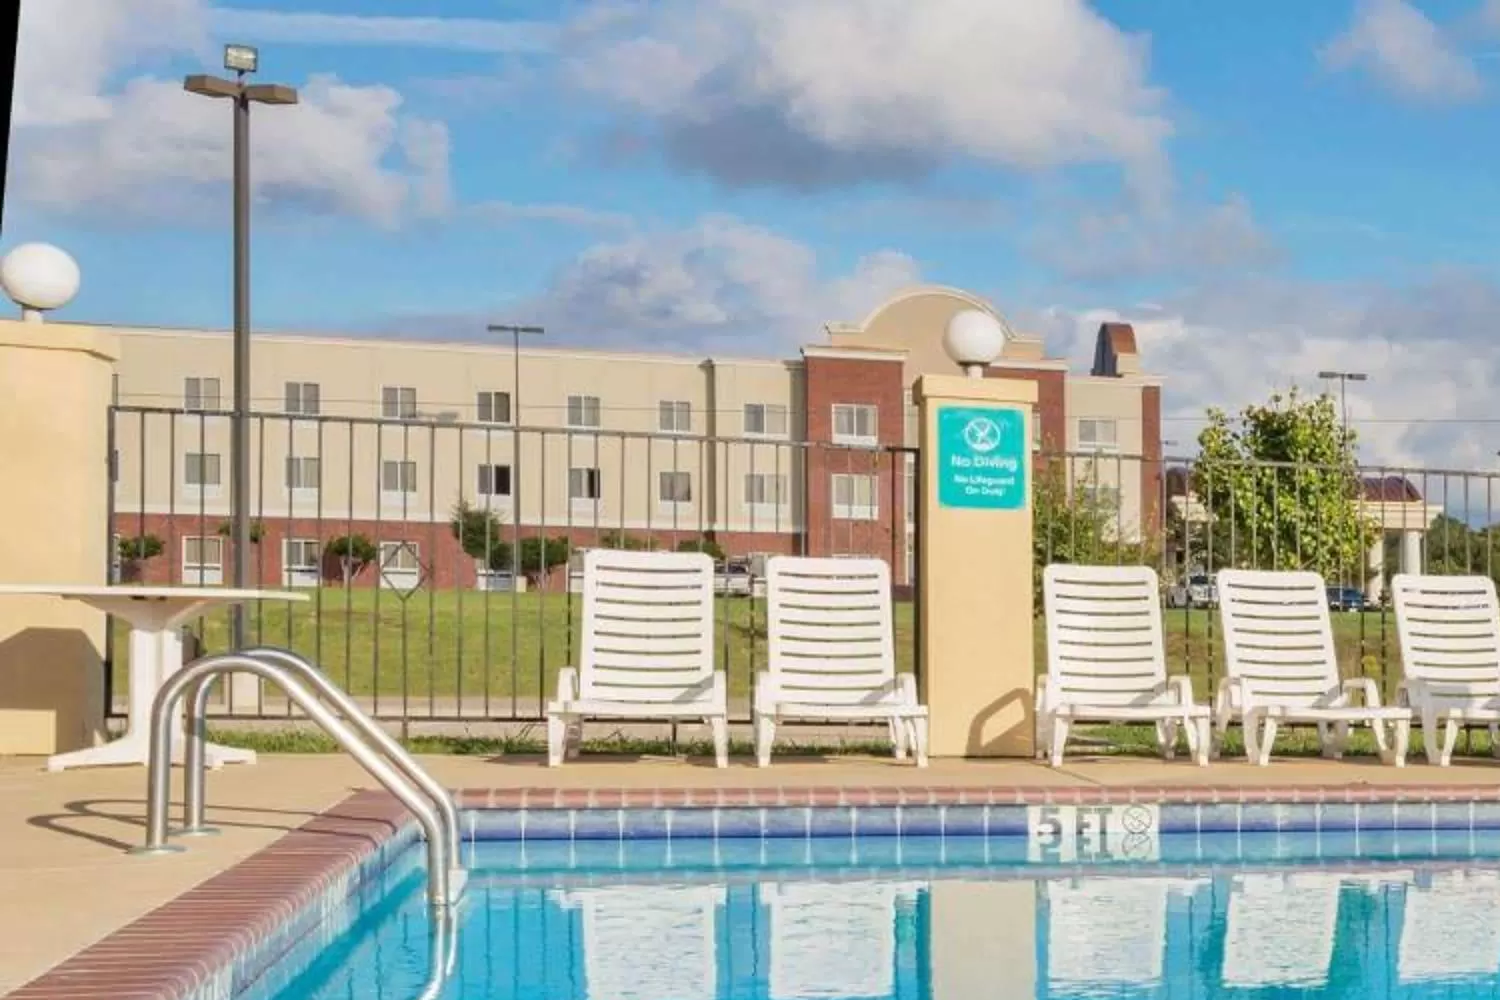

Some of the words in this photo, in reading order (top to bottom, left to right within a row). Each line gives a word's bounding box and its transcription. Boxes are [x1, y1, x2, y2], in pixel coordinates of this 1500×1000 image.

[951, 454, 972, 468] No
[973, 455, 1017, 472] Diving
[1037, 806, 1062, 836] 5
[1075, 807, 1113, 836] FT
